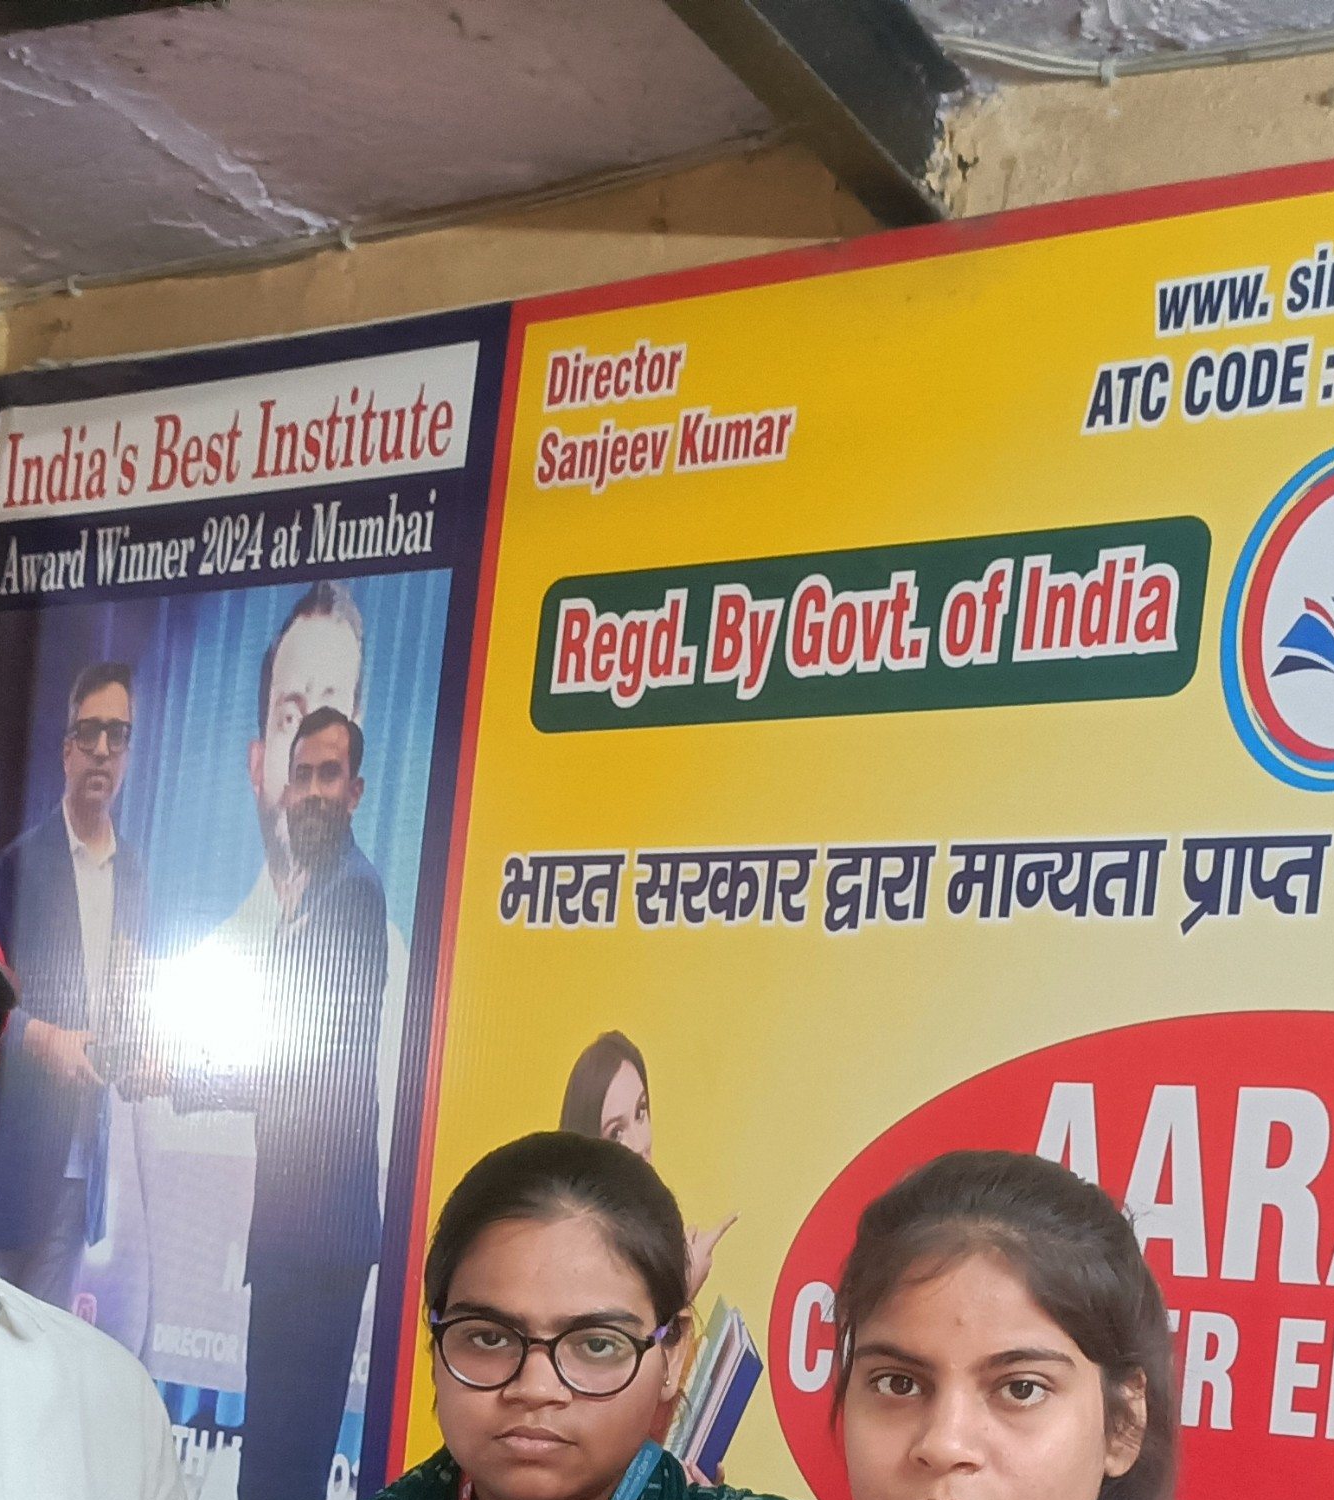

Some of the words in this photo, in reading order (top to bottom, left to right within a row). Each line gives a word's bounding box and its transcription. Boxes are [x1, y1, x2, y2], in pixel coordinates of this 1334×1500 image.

[1159, 271, 1269, 331] www.
[547, 344, 682, 407] Director
[1087, 360, 1169, 428] ATC
[1185, 343, 1308, 417] CODE
[3, 421, 138, 509] India's
[147, 408, 240, 493] Best
[251, 387, 453, 478] Institute
[537, 424, 668, 490] Sanjeev
[679, 409, 794, 466] Kumar
[0, 530, 86, 594] Award
[96, 524, 195, 586] Winner
[199, 511, 265, 576] 2024
[270, 520, 301, 568] at
[307, 490, 434, 560] Mumbai
[557, 604, 691, 698] Regd.
[711, 594, 775, 690] By
[792, 582, 923, 666] Govt.
[945, 560, 1009, 658] of
[1022, 558, 1173, 650] India
[502, 853, 624, 926] भारत
[636, 849, 816, 925] सरकार
[825, 846, 934, 931] द्वारा
[948, 840, 1167, 921] मान्यता
[1182, 834, 1332, 936] प्राप्त
